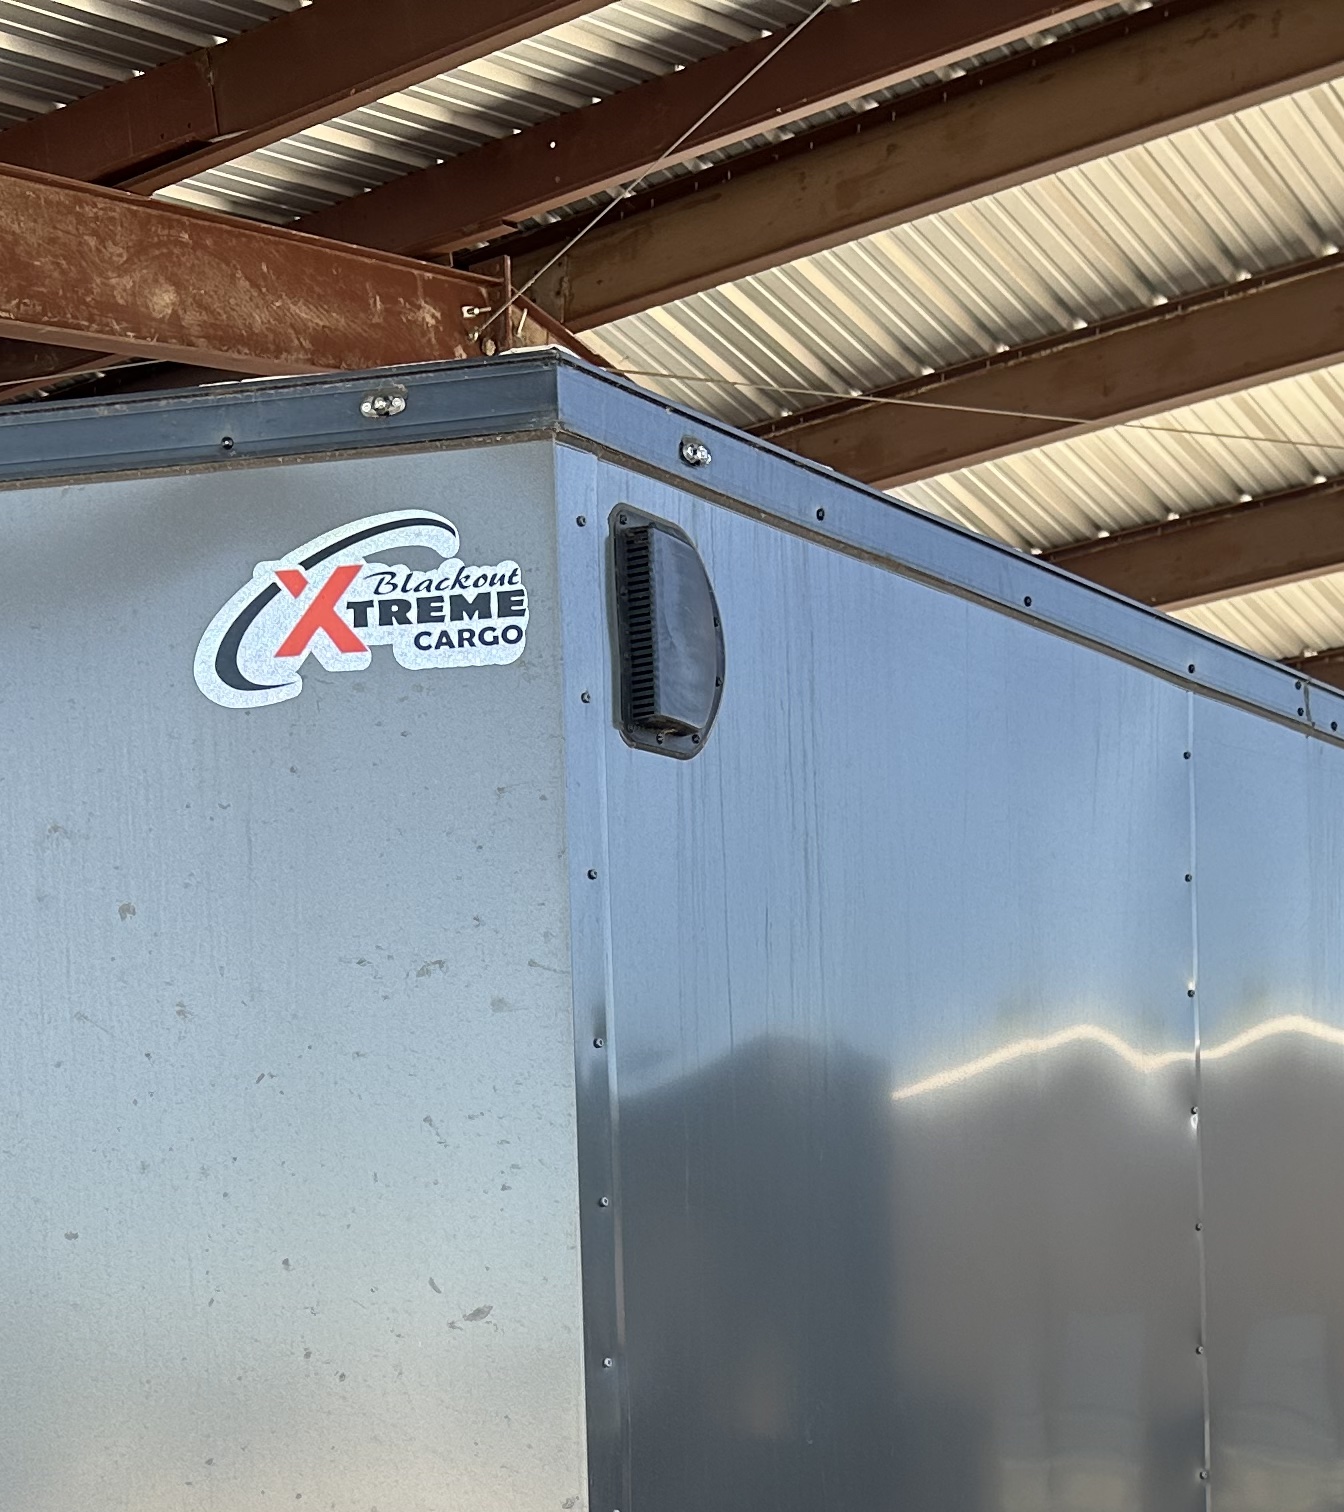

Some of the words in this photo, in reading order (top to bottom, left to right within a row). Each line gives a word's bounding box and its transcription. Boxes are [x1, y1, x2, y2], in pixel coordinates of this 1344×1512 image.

[363, 566, 519, 596] Blackout
[273, 564, 527, 658] XTREME
[413, 624, 524, 652] CARGO
